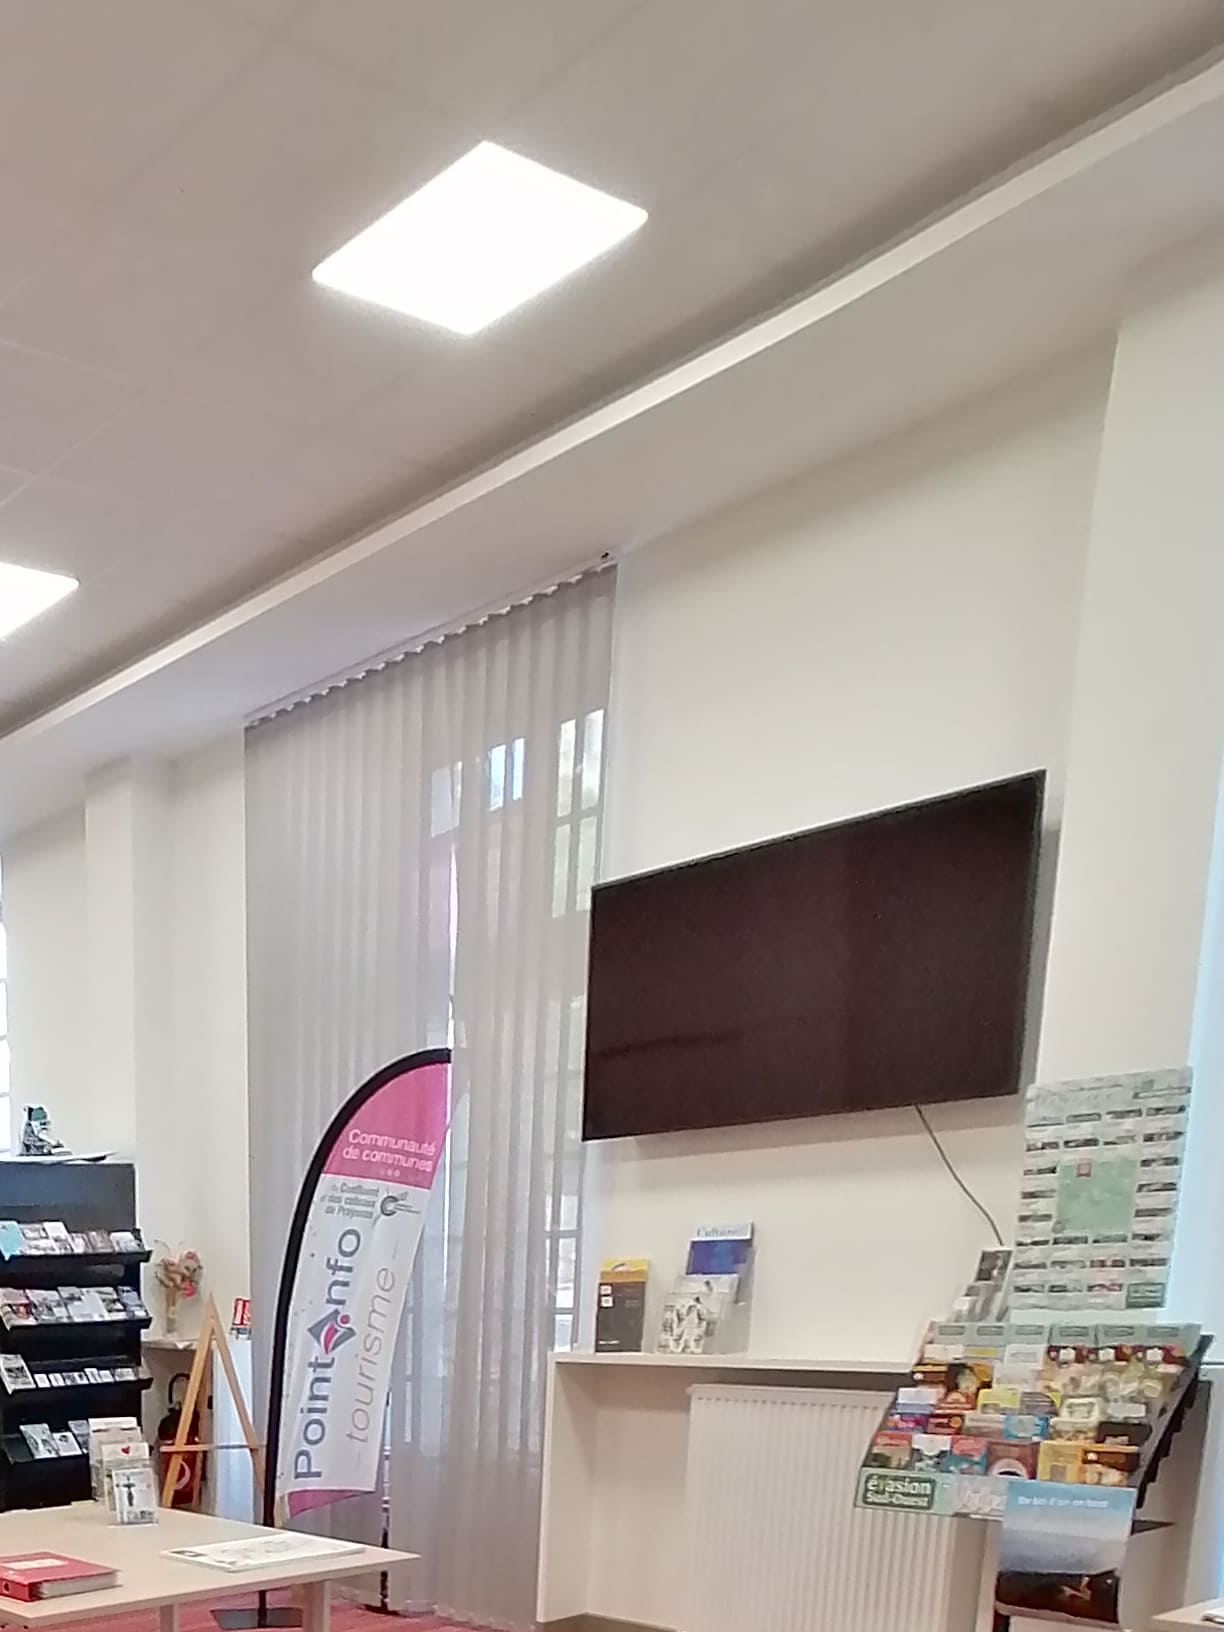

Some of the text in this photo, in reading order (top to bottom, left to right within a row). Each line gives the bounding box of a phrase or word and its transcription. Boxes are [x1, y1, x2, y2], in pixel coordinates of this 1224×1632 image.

[342, 1145, 434, 1172] de communes
[348, 1129, 436, 1156] Communauté
[345, 1266, 396, 1444] tourisme
[292, 1355, 336, 1481] Point
